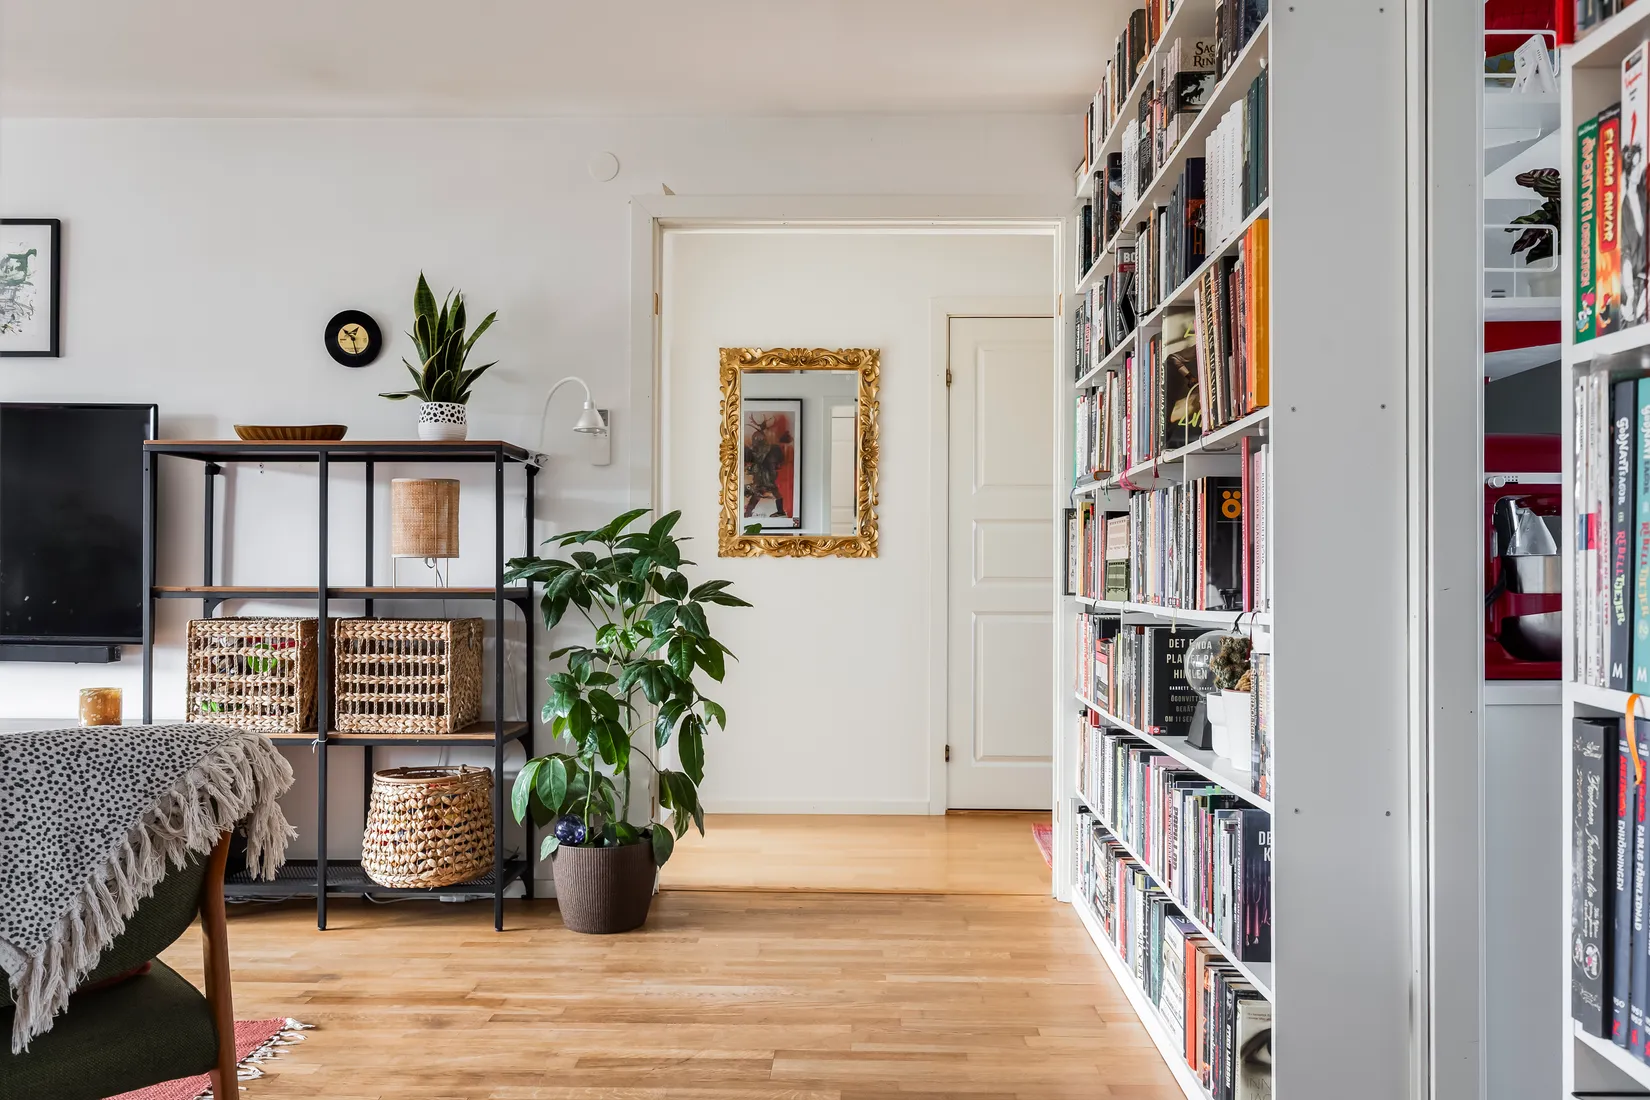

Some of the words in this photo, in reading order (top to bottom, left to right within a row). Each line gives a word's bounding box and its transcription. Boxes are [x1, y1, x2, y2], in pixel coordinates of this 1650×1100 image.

[1195, 41, 1215, 56] SAG
[1193, 56, 1216, 68] RIN
[1613, 530, 1626, 626] REBELLTJEJER
[1168, 638, 1186, 648] DET
[1258, 830, 1271, 846] DE
[1636, 824, 1645, 861] FARLIG
[1616, 820, 1626, 892] ENHÖRNINGEN
